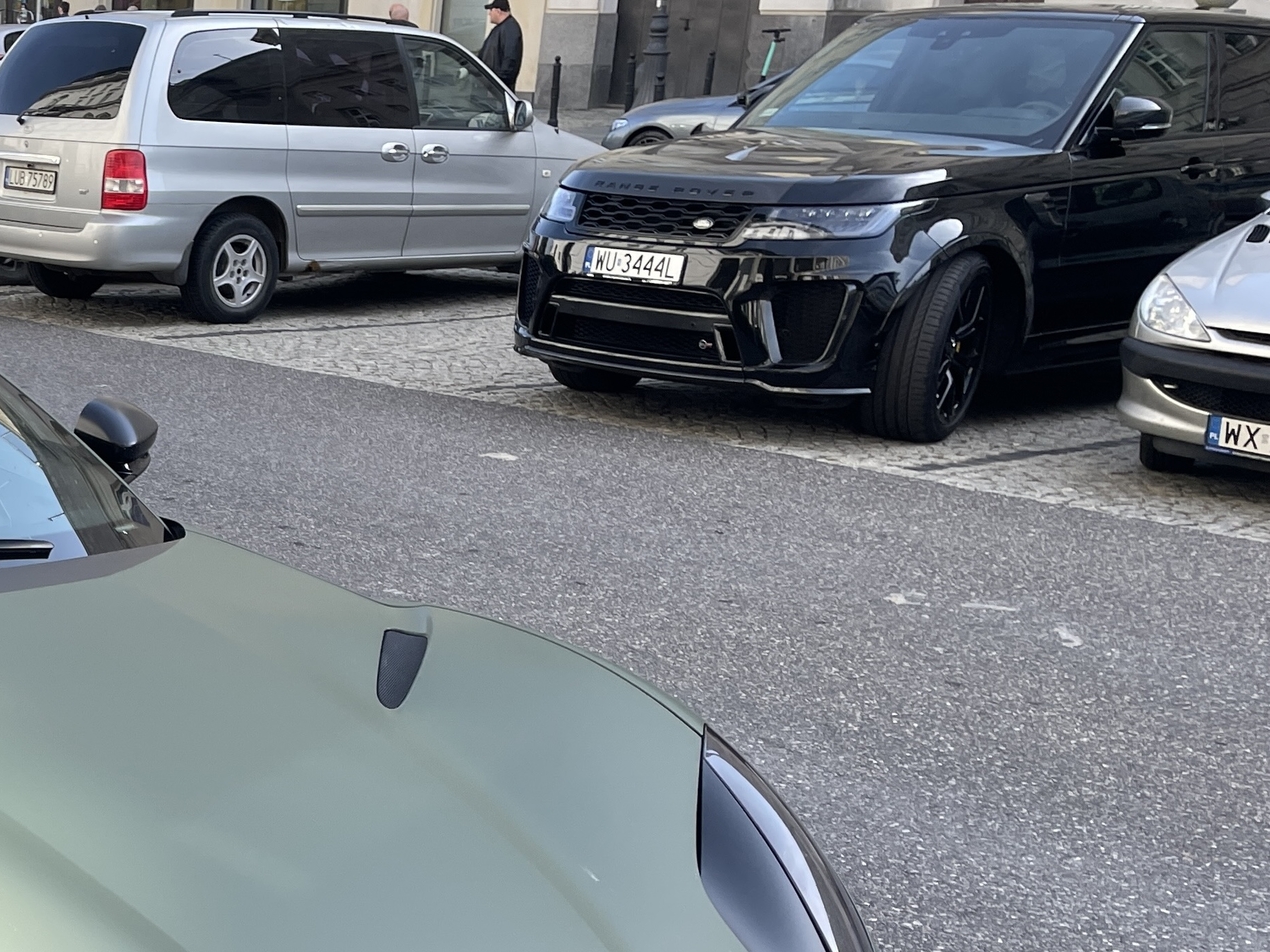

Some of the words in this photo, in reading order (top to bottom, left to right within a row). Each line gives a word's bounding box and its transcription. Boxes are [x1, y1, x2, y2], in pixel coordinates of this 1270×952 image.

[9, 169, 25, 186] LUB
[27, 171, 54, 189] 75789
[595, 249, 618, 272] WU
[622, 253, 675, 279] 3444L
[1225, 421, 1261, 450] WX
